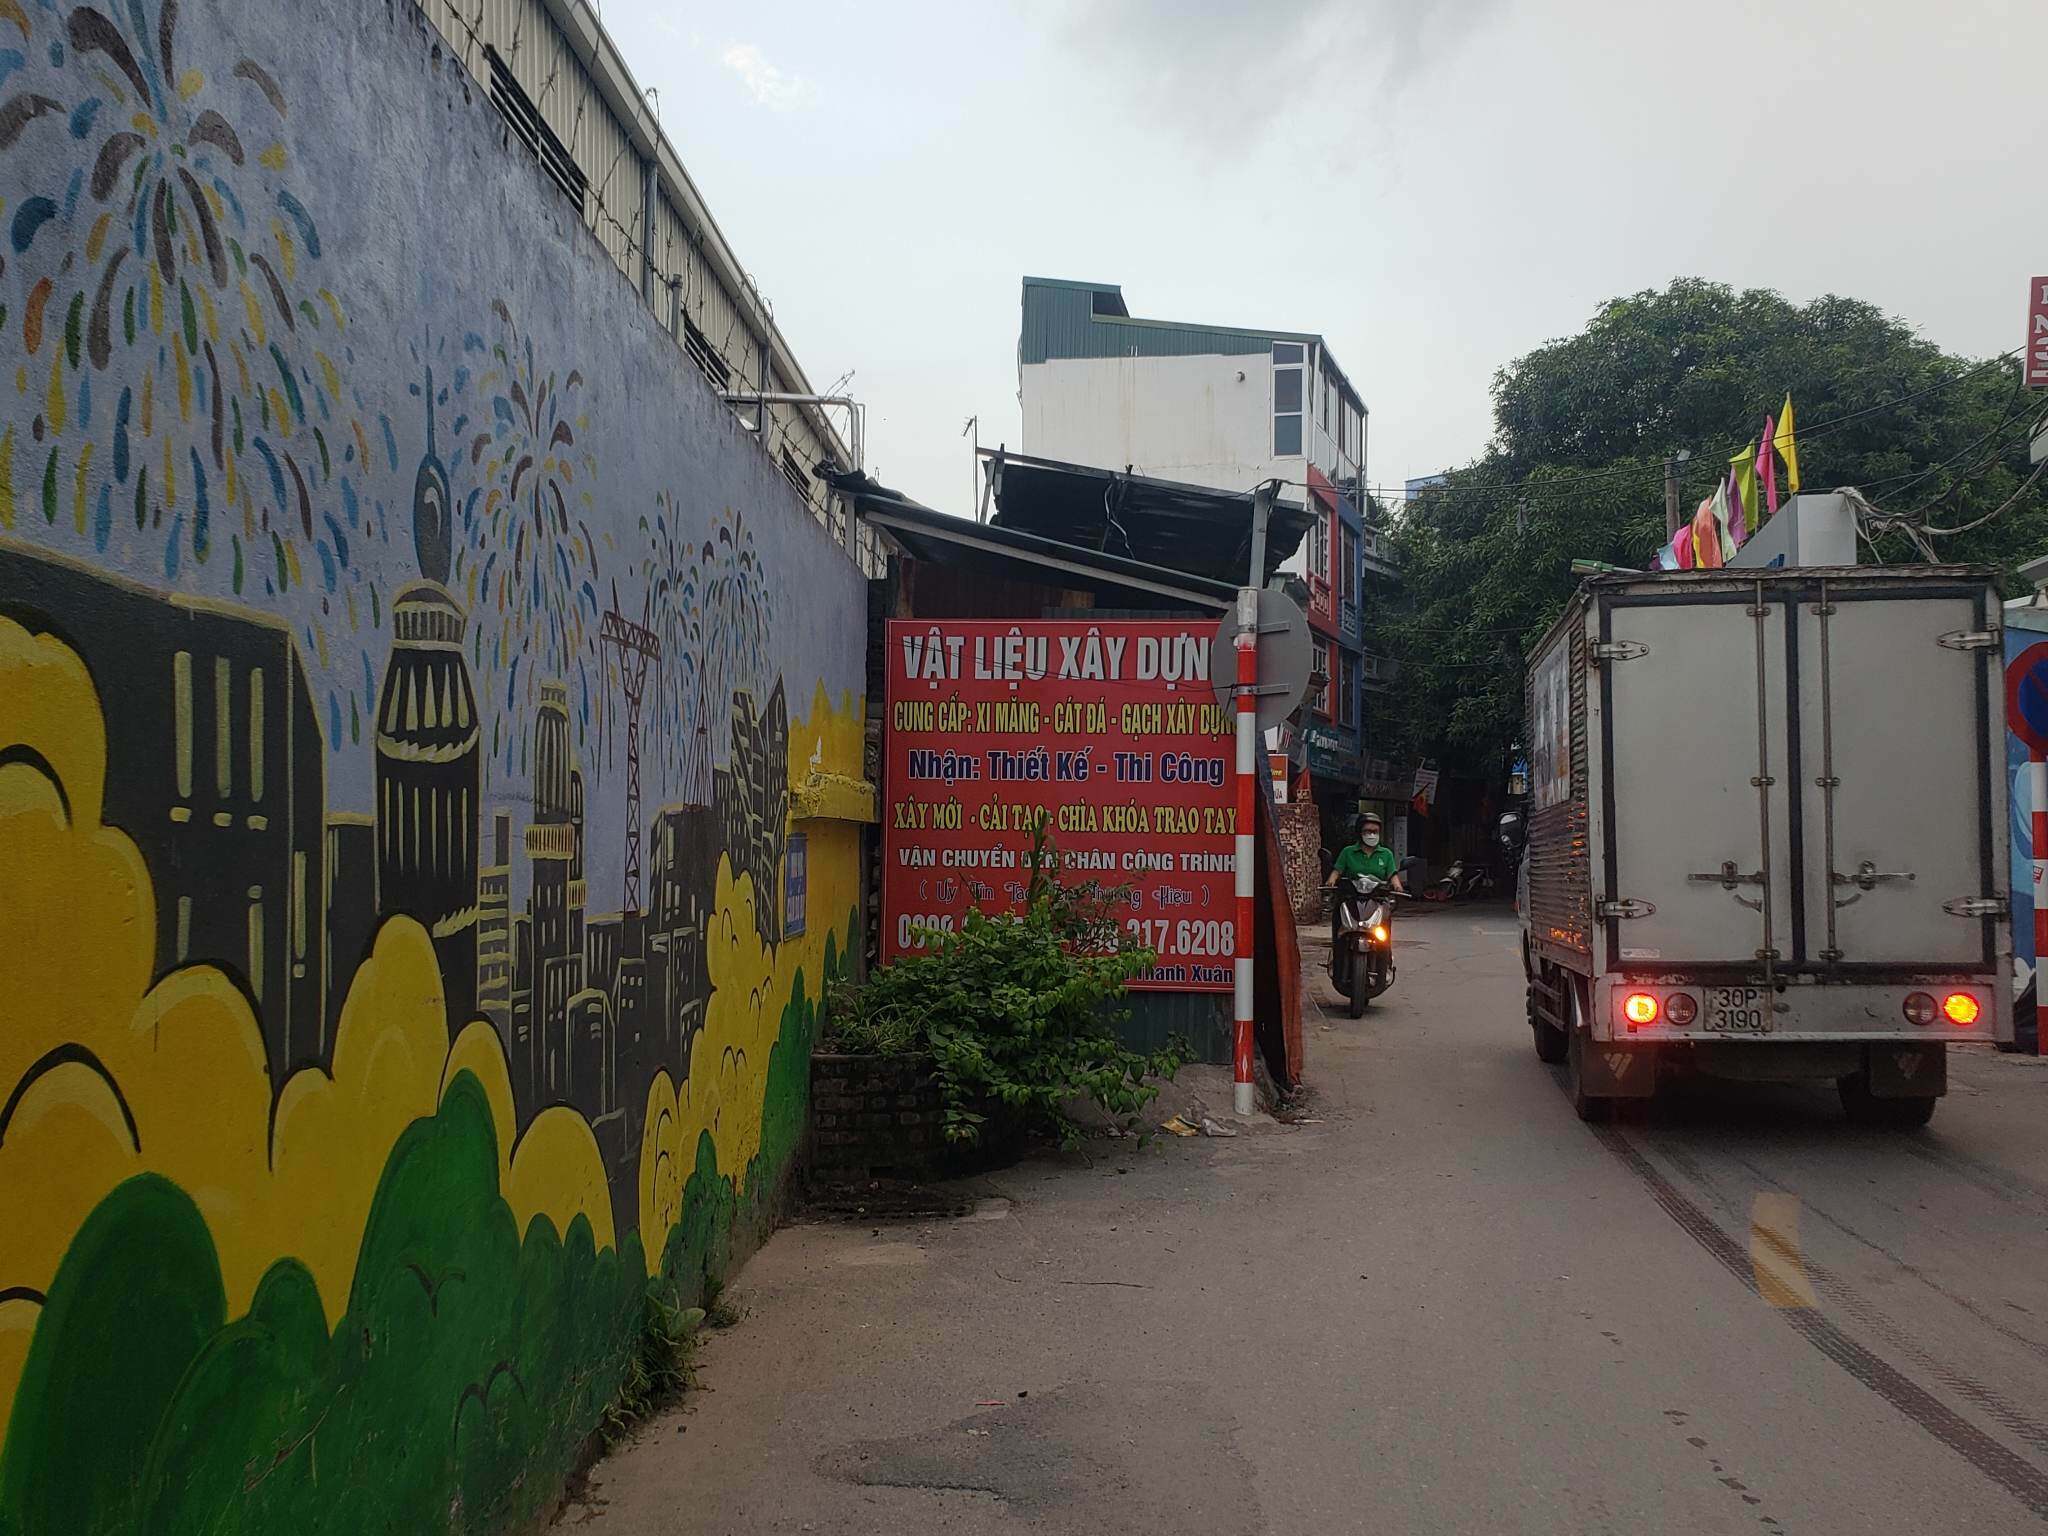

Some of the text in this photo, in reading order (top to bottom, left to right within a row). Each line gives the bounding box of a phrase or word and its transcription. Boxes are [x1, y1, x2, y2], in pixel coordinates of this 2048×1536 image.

[903, 627, 1216, 690] VẬT LIỆU XÂY DỰN
[894, 700, 934, 733] CUNG
[938, 691, 973, 733] CẤP:
[975, 701, 991, 733] XI
[995, 696, 1040, 733] MĂNG
[1053, 695, 1083, 735] CÁT
[1086, 695, 1107, 735] ĐÁ
[1121, 702, 1162, 742] GẠCH
[1166, 697, 1196, 735] XÂY
[908, 749, 980, 786] Nhận:
[987, 745, 1049, 783] Thiết
[1056, 745, 1095, 783] Kế
[1113, 752, 1152, 783] Thi
[1160, 752, 1225, 788] Công
[894, 795, 930, 830] XÂY
[933, 795, 963, 830] MỚI
[979, 792, 1009, 831] CẢI
[1012, 803, 1045, 840] TẠO
[1058, 798, 1099, 833] CHÌA
[1102, 798, 1149, 834] KHÓA
[1153, 806, 1200, 835] TRAO
[1204, 807, 1237, 835] TAY
[899, 845, 936, 870] VẬN
[942, 843, 1015, 868] CHUYỂN
[1064, 849, 1116, 870] CHÂN
[1121, 849, 1174, 872] CÔNG
[1179, 850, 1237, 872] TRÌNH
[1191, 965, 1233, 983] Xuân
[1718, 988, 1758, 1008] 30P
[1714, 1009, 1761, 1029] 3190
